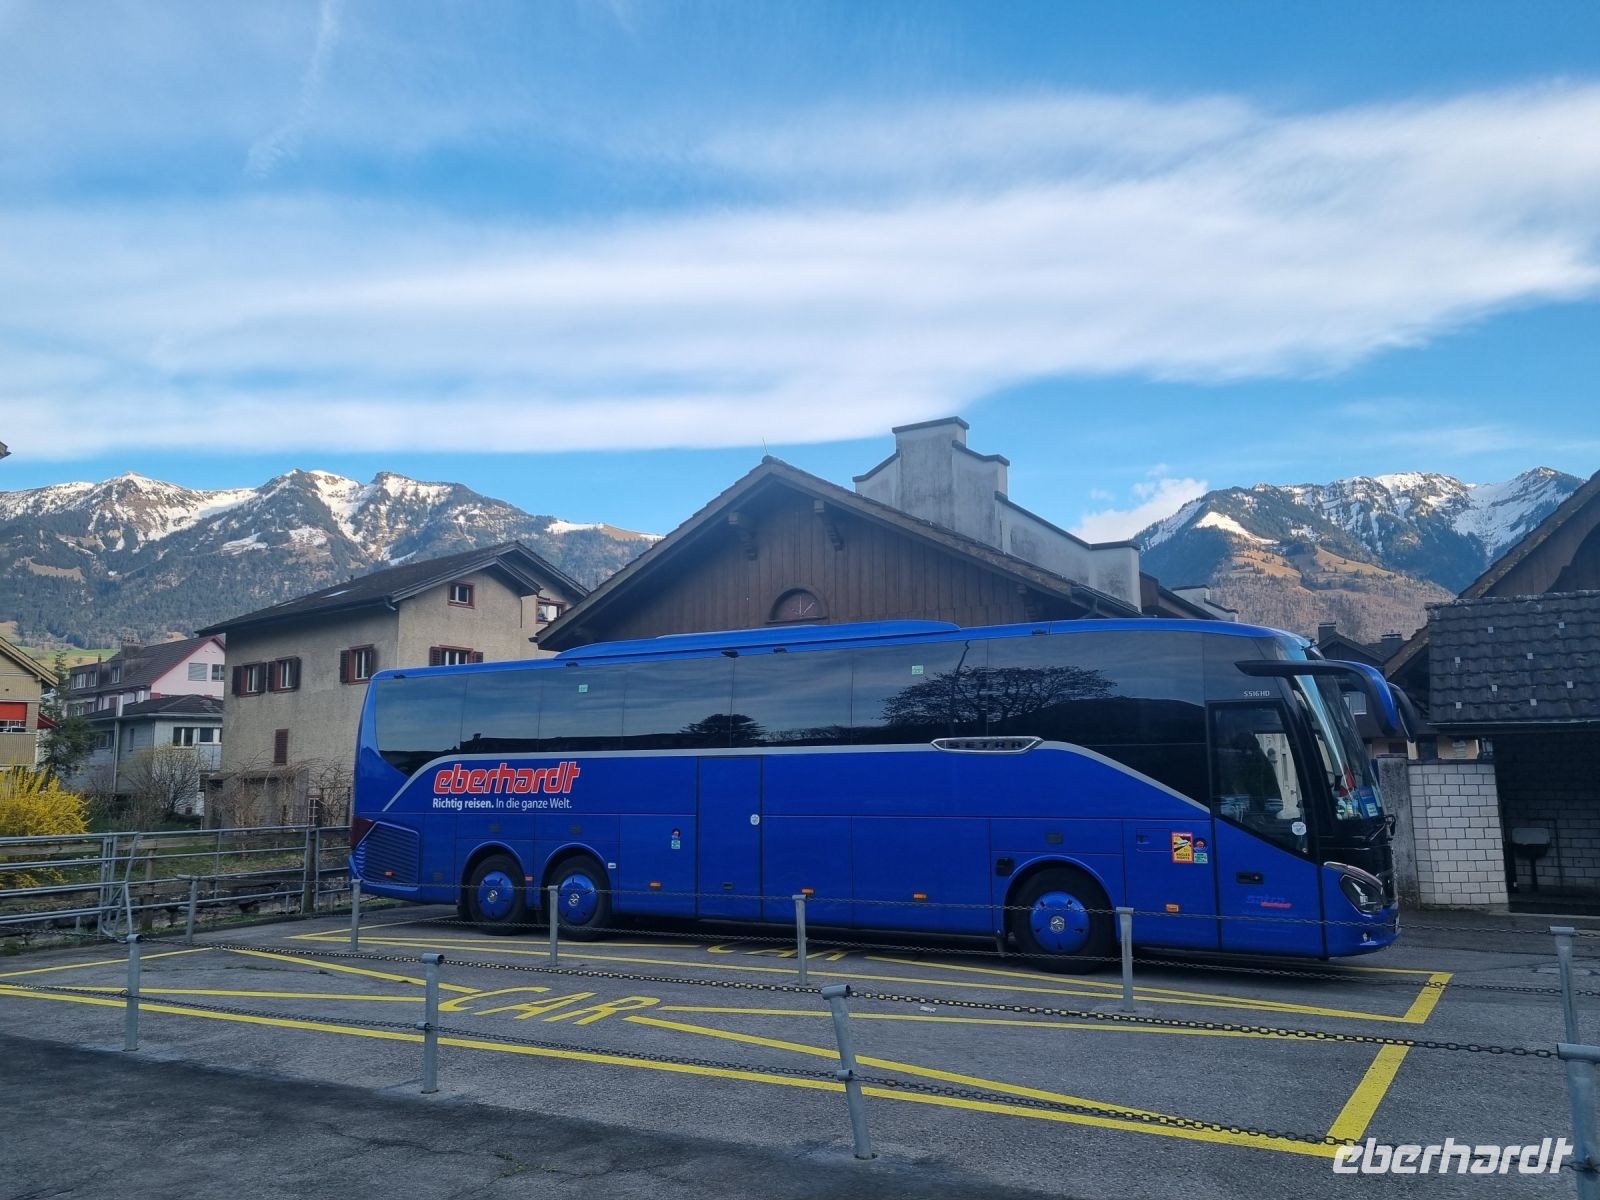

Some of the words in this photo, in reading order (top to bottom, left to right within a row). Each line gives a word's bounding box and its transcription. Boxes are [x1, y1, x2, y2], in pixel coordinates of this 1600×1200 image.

[947, 740, 1023, 749] SETRA
[433, 761, 581, 794] eberhardt
[432, 797, 463, 811] Richtig
[464, 797, 494, 809] reisen.
[496, 797, 505, 809] In
[506, 797, 519, 809] die
[521, 799, 548, 811] ganze
[549, 797, 573, 809] Welt.
[438, 986, 661, 1026] CAR
